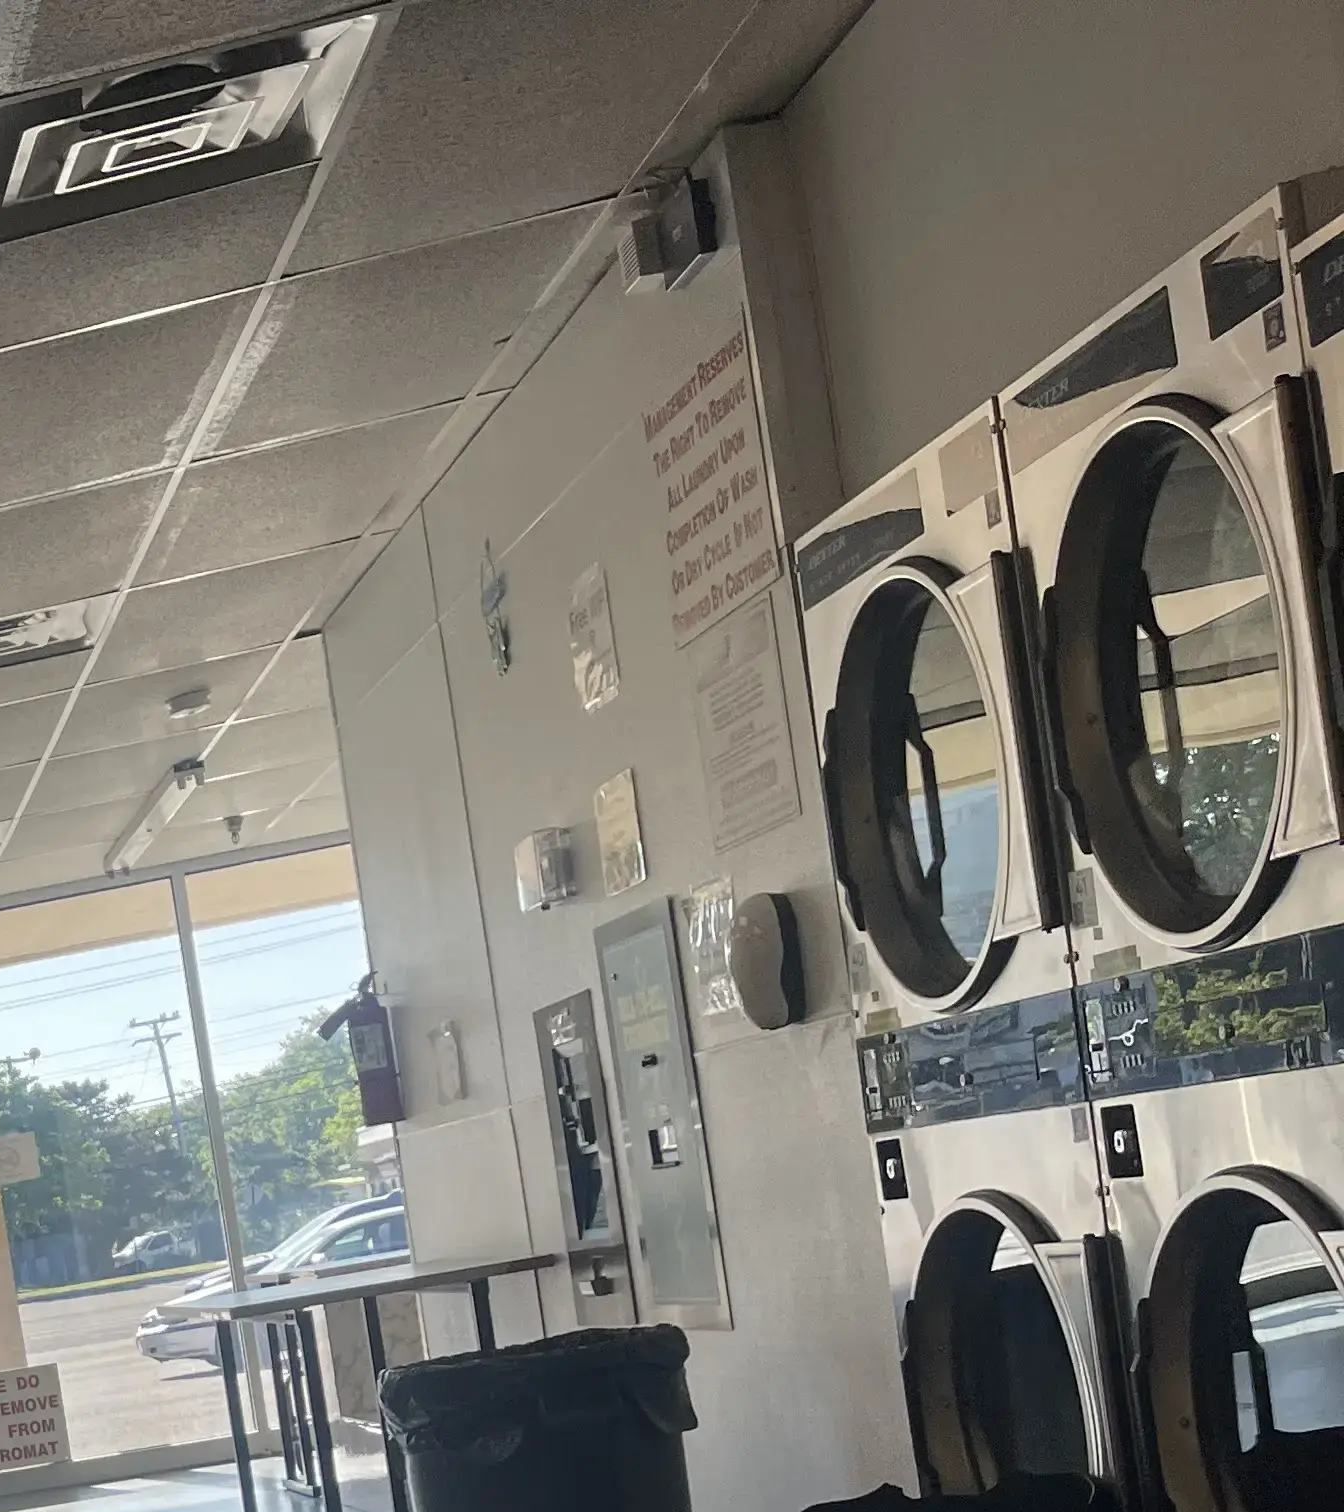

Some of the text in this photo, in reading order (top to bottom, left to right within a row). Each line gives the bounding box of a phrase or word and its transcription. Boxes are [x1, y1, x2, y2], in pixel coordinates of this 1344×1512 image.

[697, 331, 744, 391] RESERVES
[695, 411, 709, 438] TO
[17, 1375, 39, 1389] DO
[8, 1418, 55, 1438] FROM
